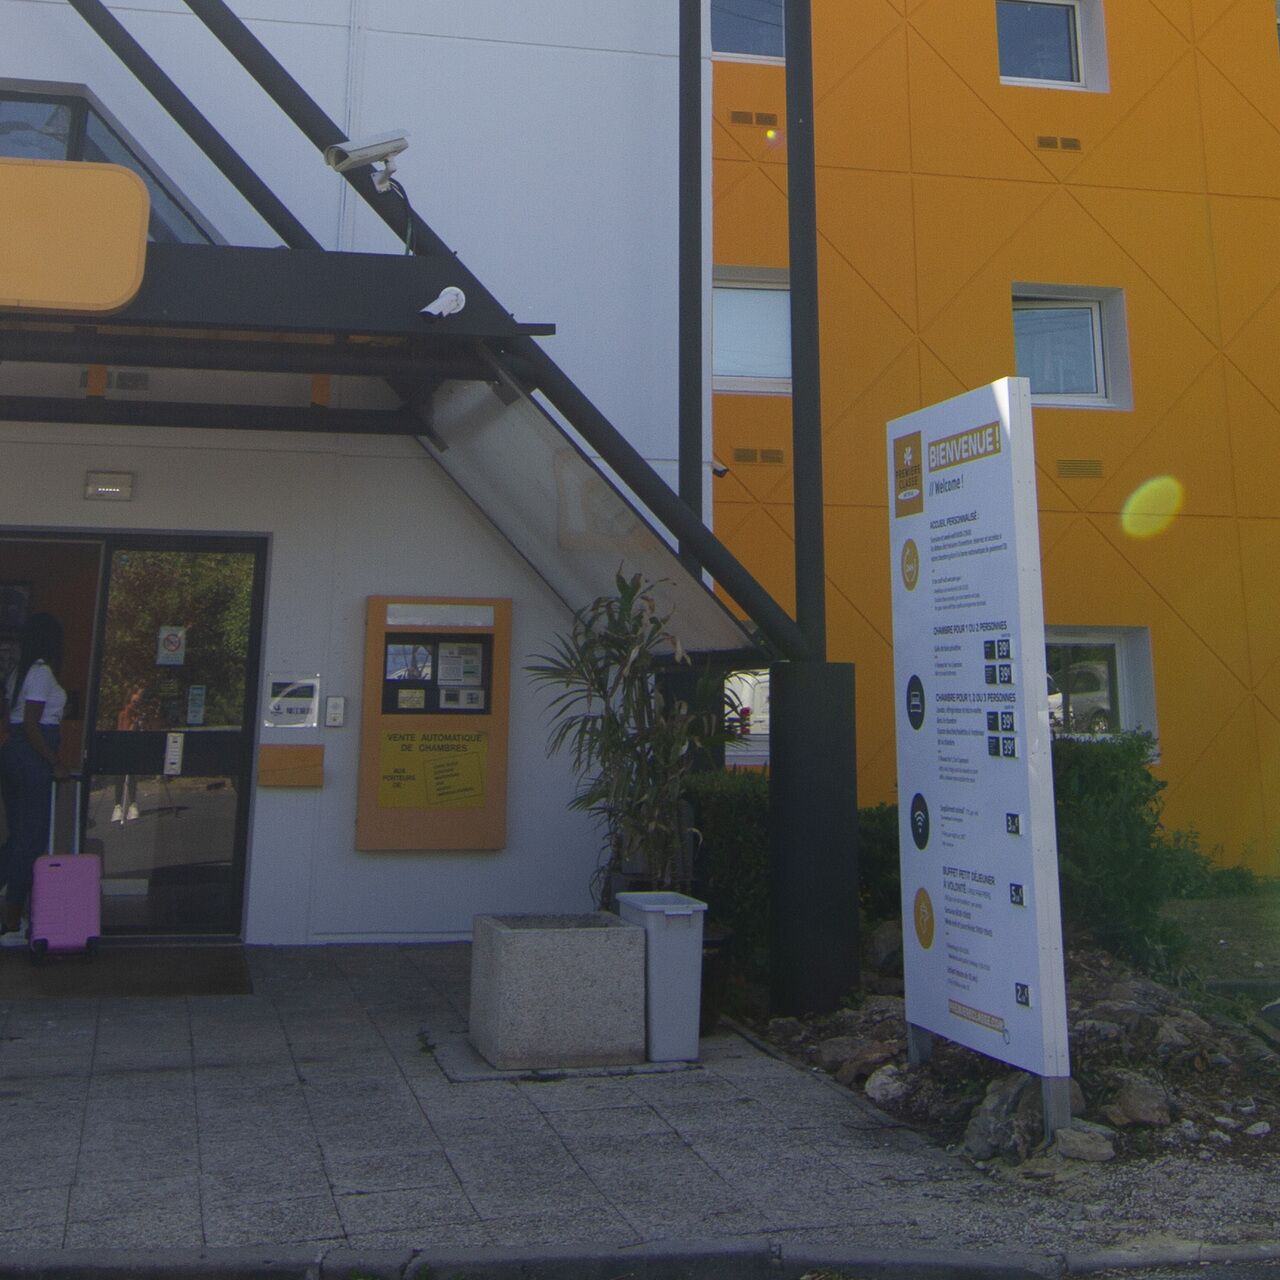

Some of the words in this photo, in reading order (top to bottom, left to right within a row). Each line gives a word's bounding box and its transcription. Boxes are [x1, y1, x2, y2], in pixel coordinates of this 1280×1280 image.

[929, 427, 993, 468] BIENVENUE
[935, 477, 961, 494] Welcome
[933, 625, 953, 635] CHAMBRE
[954, 624, 965, 634] POUR
[980, 620, 1007, 632] PERSONNES
[936, 693, 956, 703] CHAMBRE
[956, 693, 967, 703] POUR
[987, 692, 1016, 703] PERSONNES
[388, 733, 416, 742] VENTE
[421, 733, 482, 742] AUTOMATIQUE
[400, 744, 413, 752] DE
[419, 744, 469, 752] CHAMBRES
